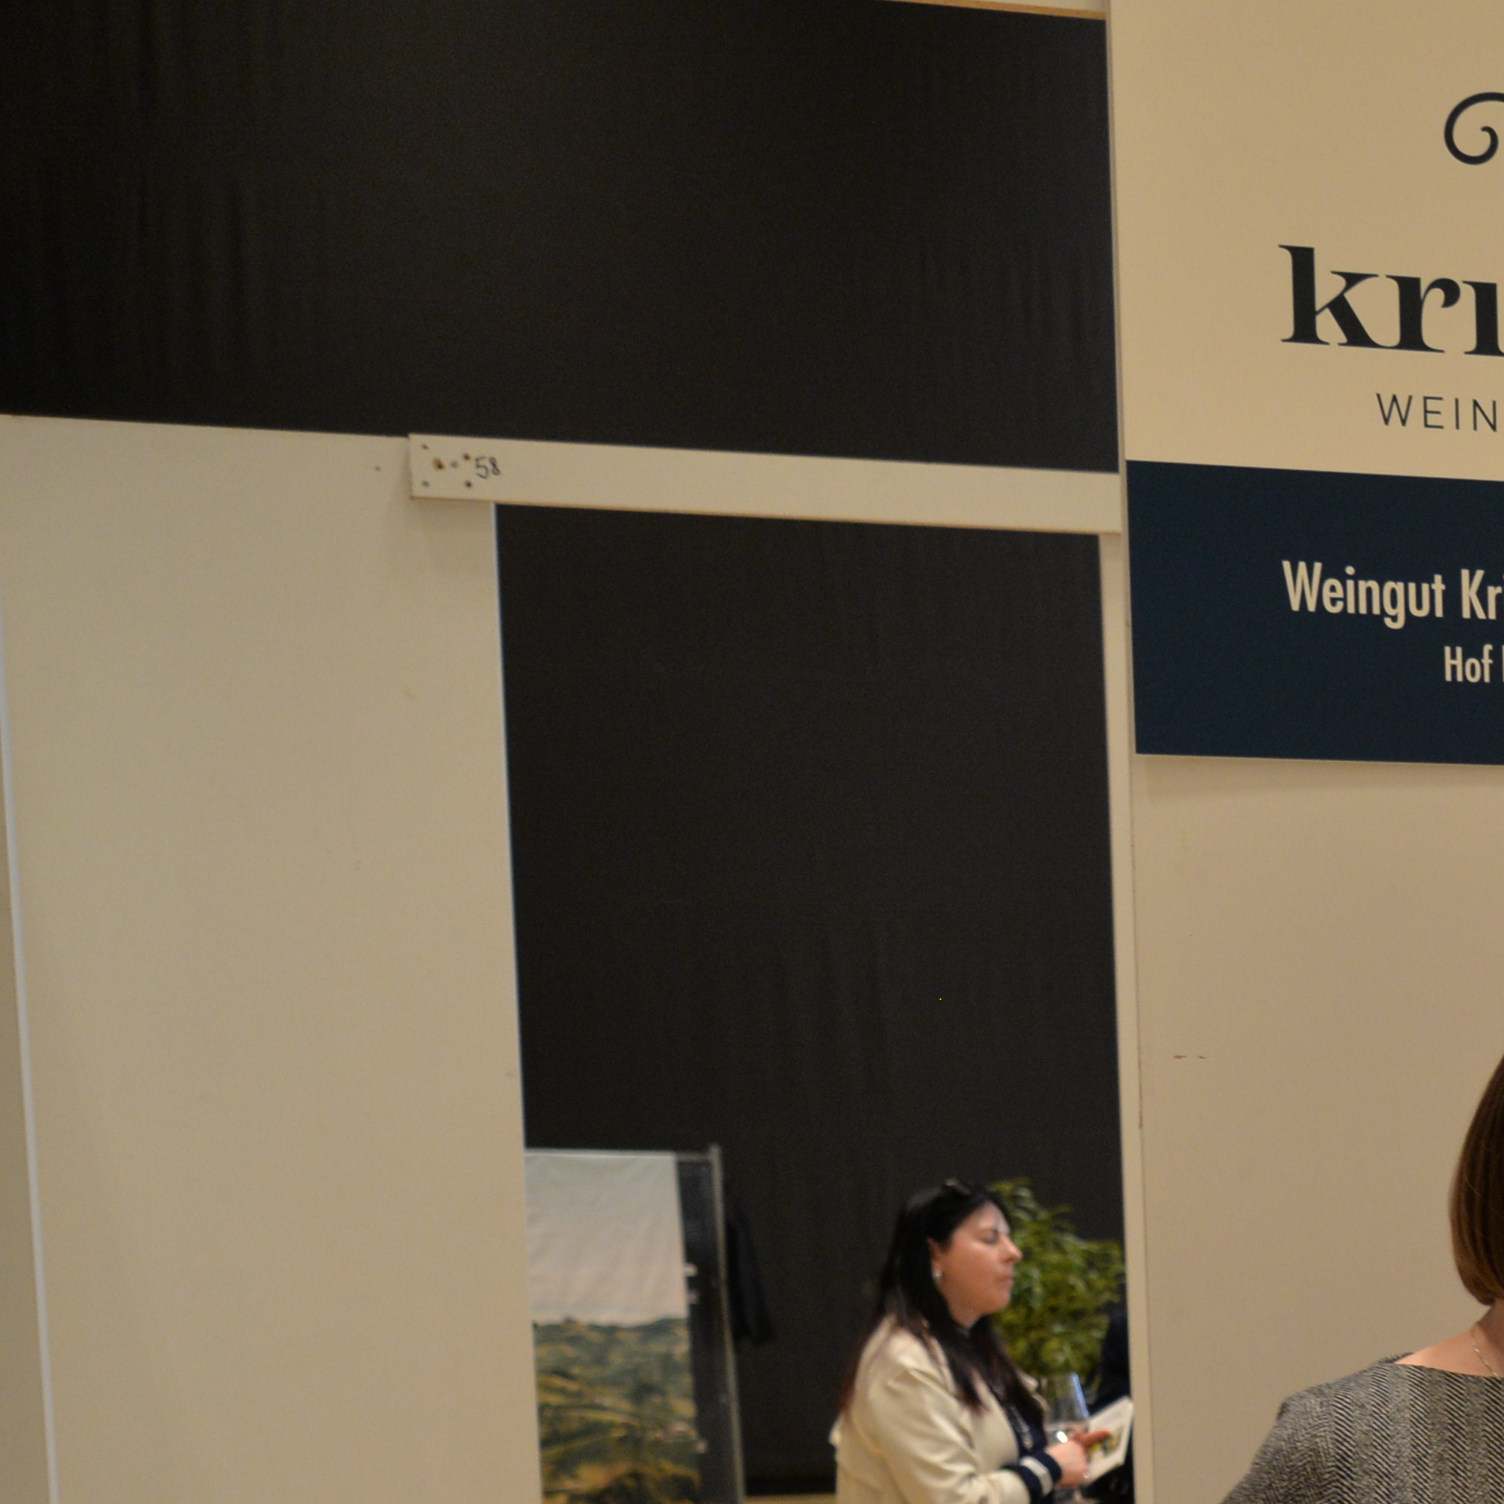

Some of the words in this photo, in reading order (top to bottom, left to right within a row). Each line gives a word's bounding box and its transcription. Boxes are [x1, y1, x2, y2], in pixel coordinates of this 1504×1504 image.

[1376, 392, 1499, 433] WEIN
[1282, 560, 1446, 629] Weingut
[1444, 646, 1494, 684] Hof
